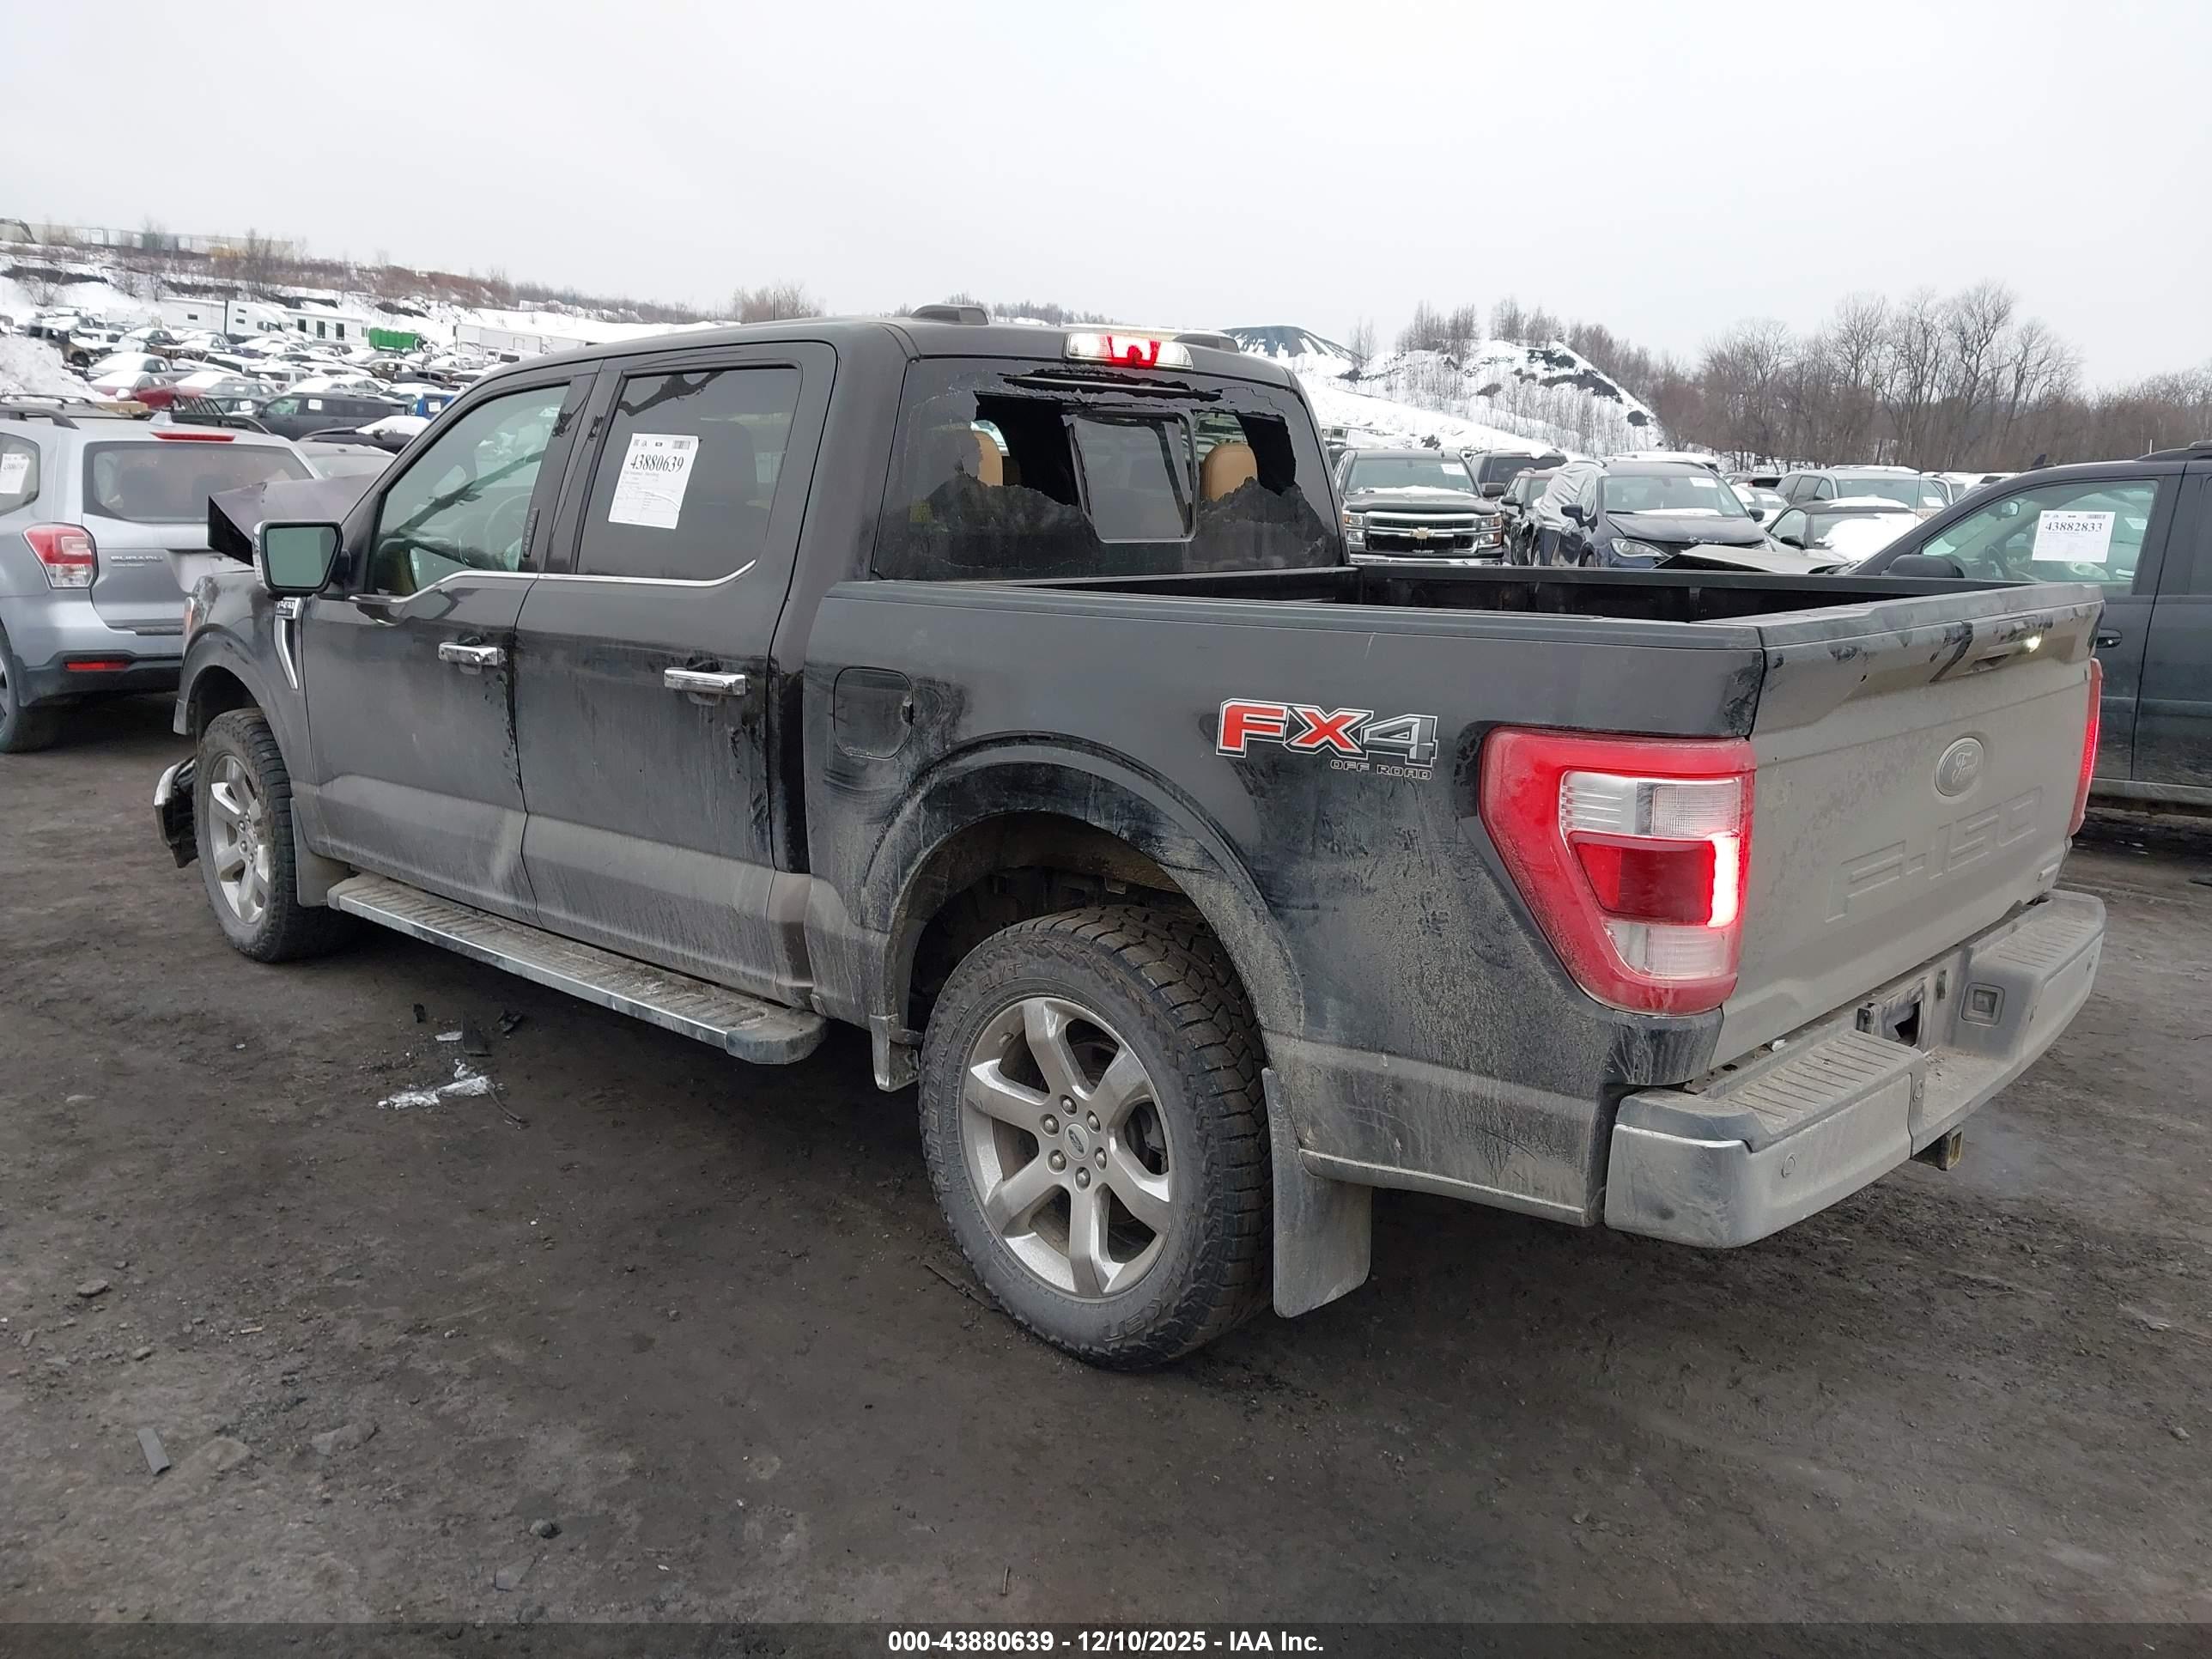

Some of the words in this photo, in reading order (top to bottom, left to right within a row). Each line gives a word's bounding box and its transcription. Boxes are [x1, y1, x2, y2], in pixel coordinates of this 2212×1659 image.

[630, 453, 684, 472] 43880639
[2045, 521, 2103, 532] 43882833
[1216, 697, 1438, 767] FX4
[1330, 759, 1370, 772] OFF
[1376, 764, 1433, 780] ROAD
[1825, 785, 2044, 924] F-150
